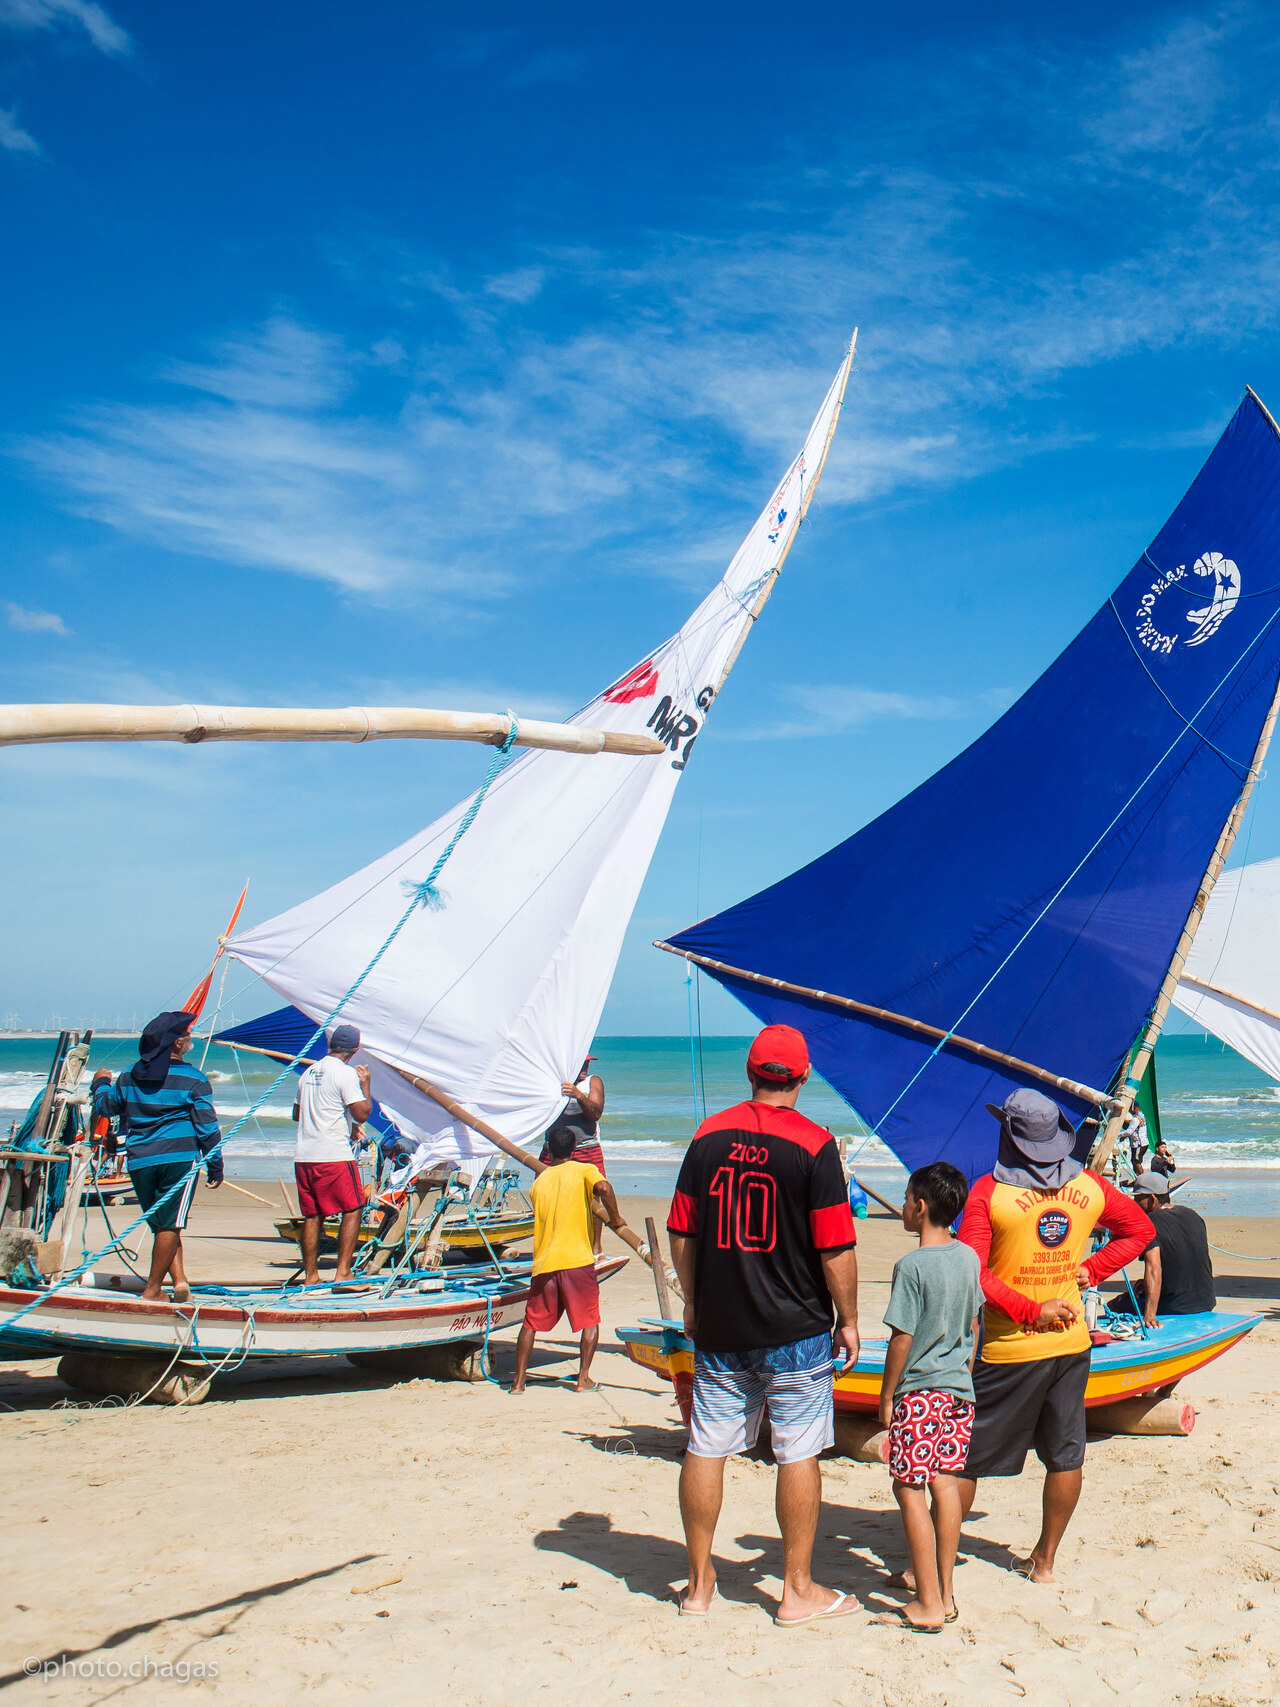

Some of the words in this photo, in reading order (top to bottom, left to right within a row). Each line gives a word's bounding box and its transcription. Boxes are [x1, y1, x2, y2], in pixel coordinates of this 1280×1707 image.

[728, 1142, 769, 1166] ZICO
[708, 1166, 778, 1253] 10
[1033, 1250, 1071, 1264] 3393.0238
[1120, 1367, 1155, 1388] ELIAS
